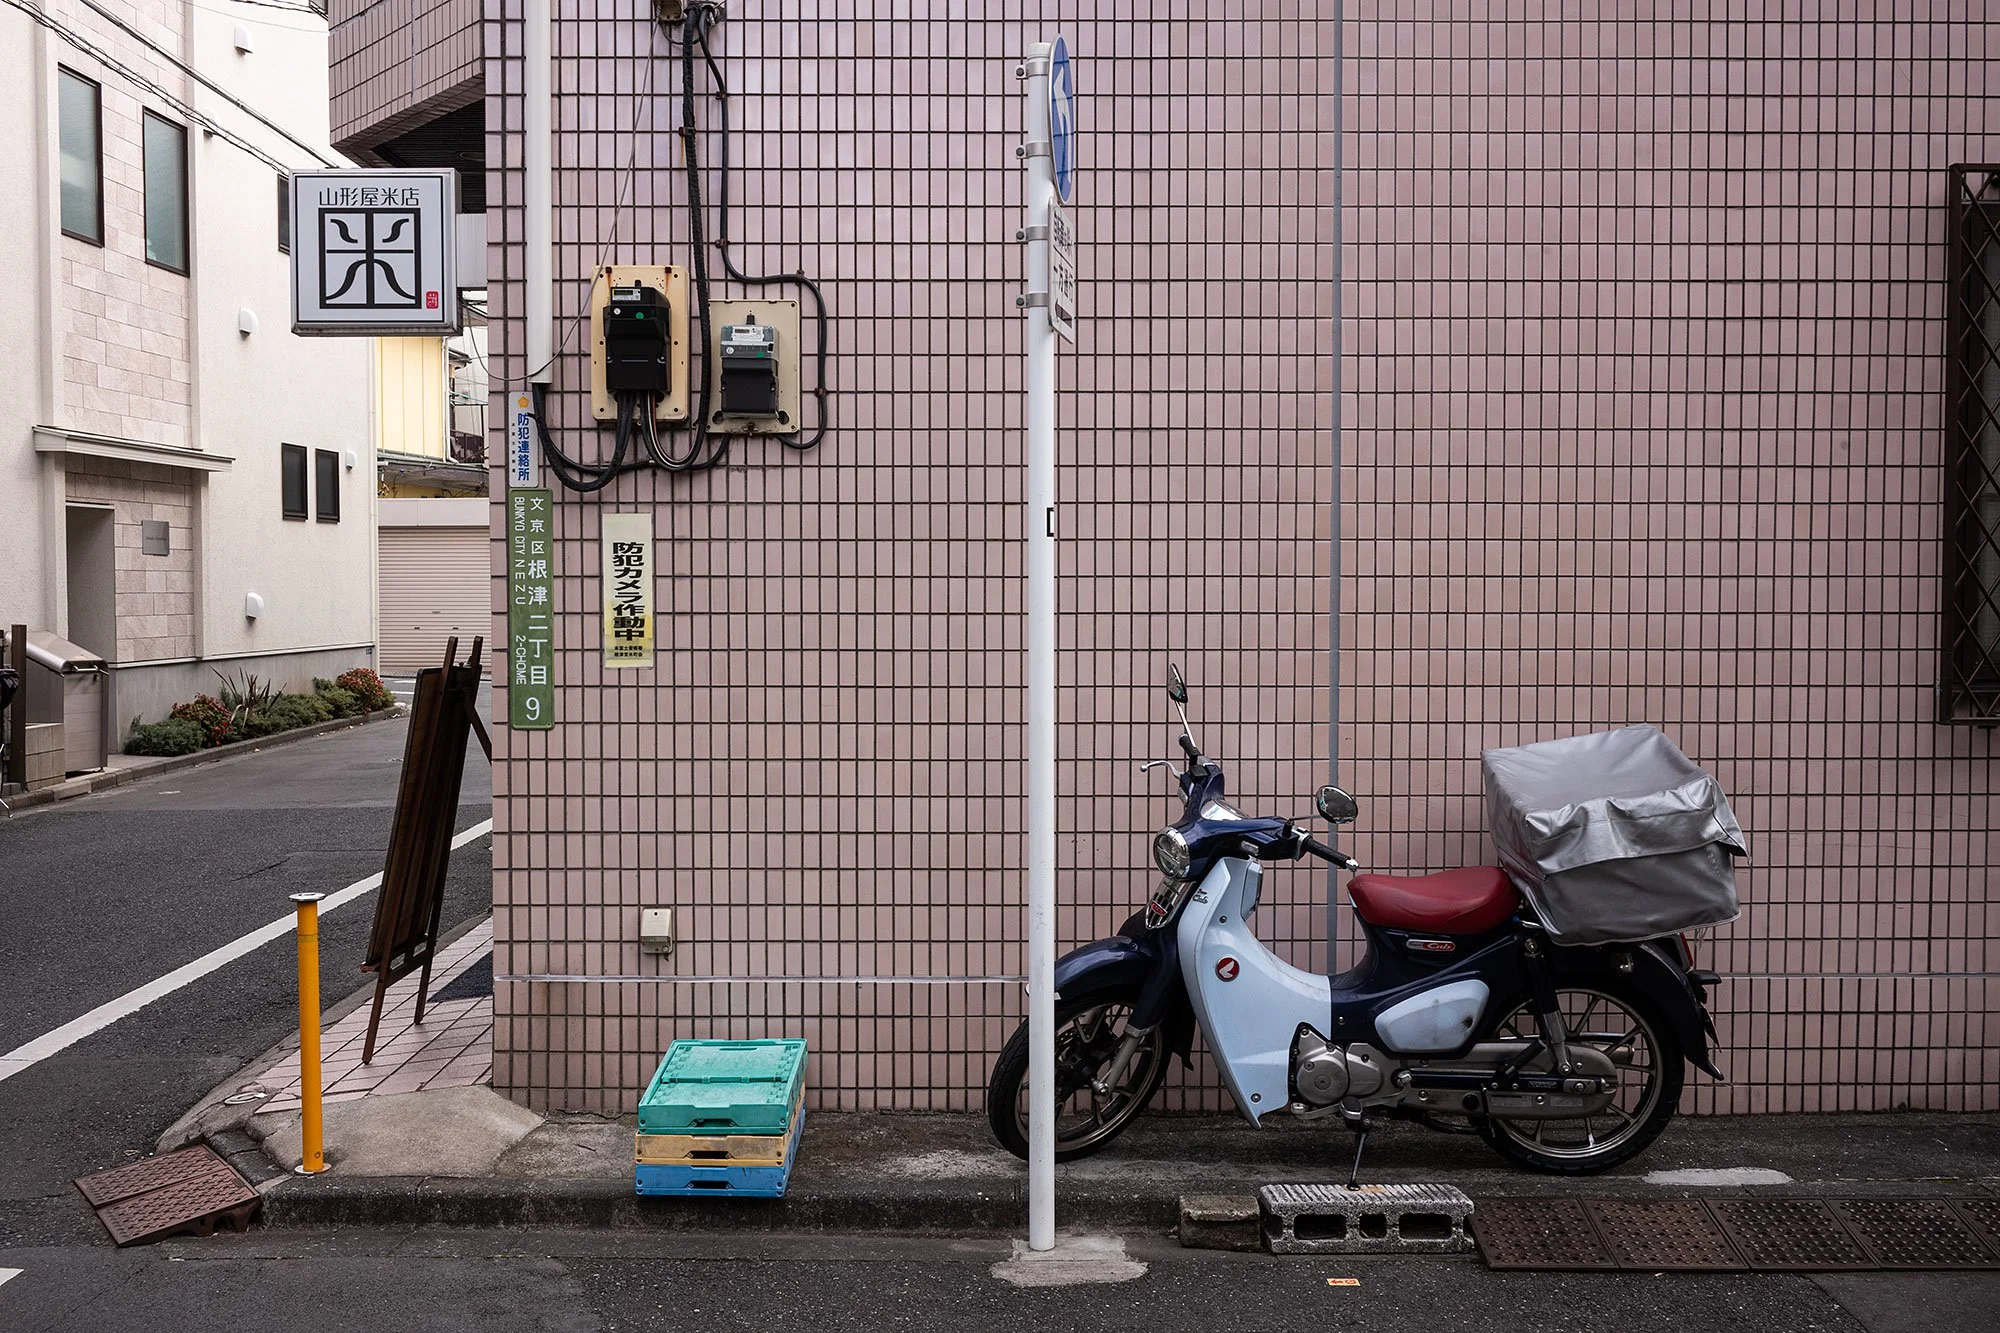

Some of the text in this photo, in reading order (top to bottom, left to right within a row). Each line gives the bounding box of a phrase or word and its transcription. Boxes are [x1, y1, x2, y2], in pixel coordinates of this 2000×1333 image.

[319, 187, 420, 206] 山形屋米店
[517, 412, 530, 481] 防犯連絡所
[514, 496, 527, 685] BUNKYO CITY NEZU 2-CHOME
[612, 542, 645, 641] 防犯カメラ作動中
[526, 697, 540, 721] 9
[1427, 942, 1451, 950] Cub
